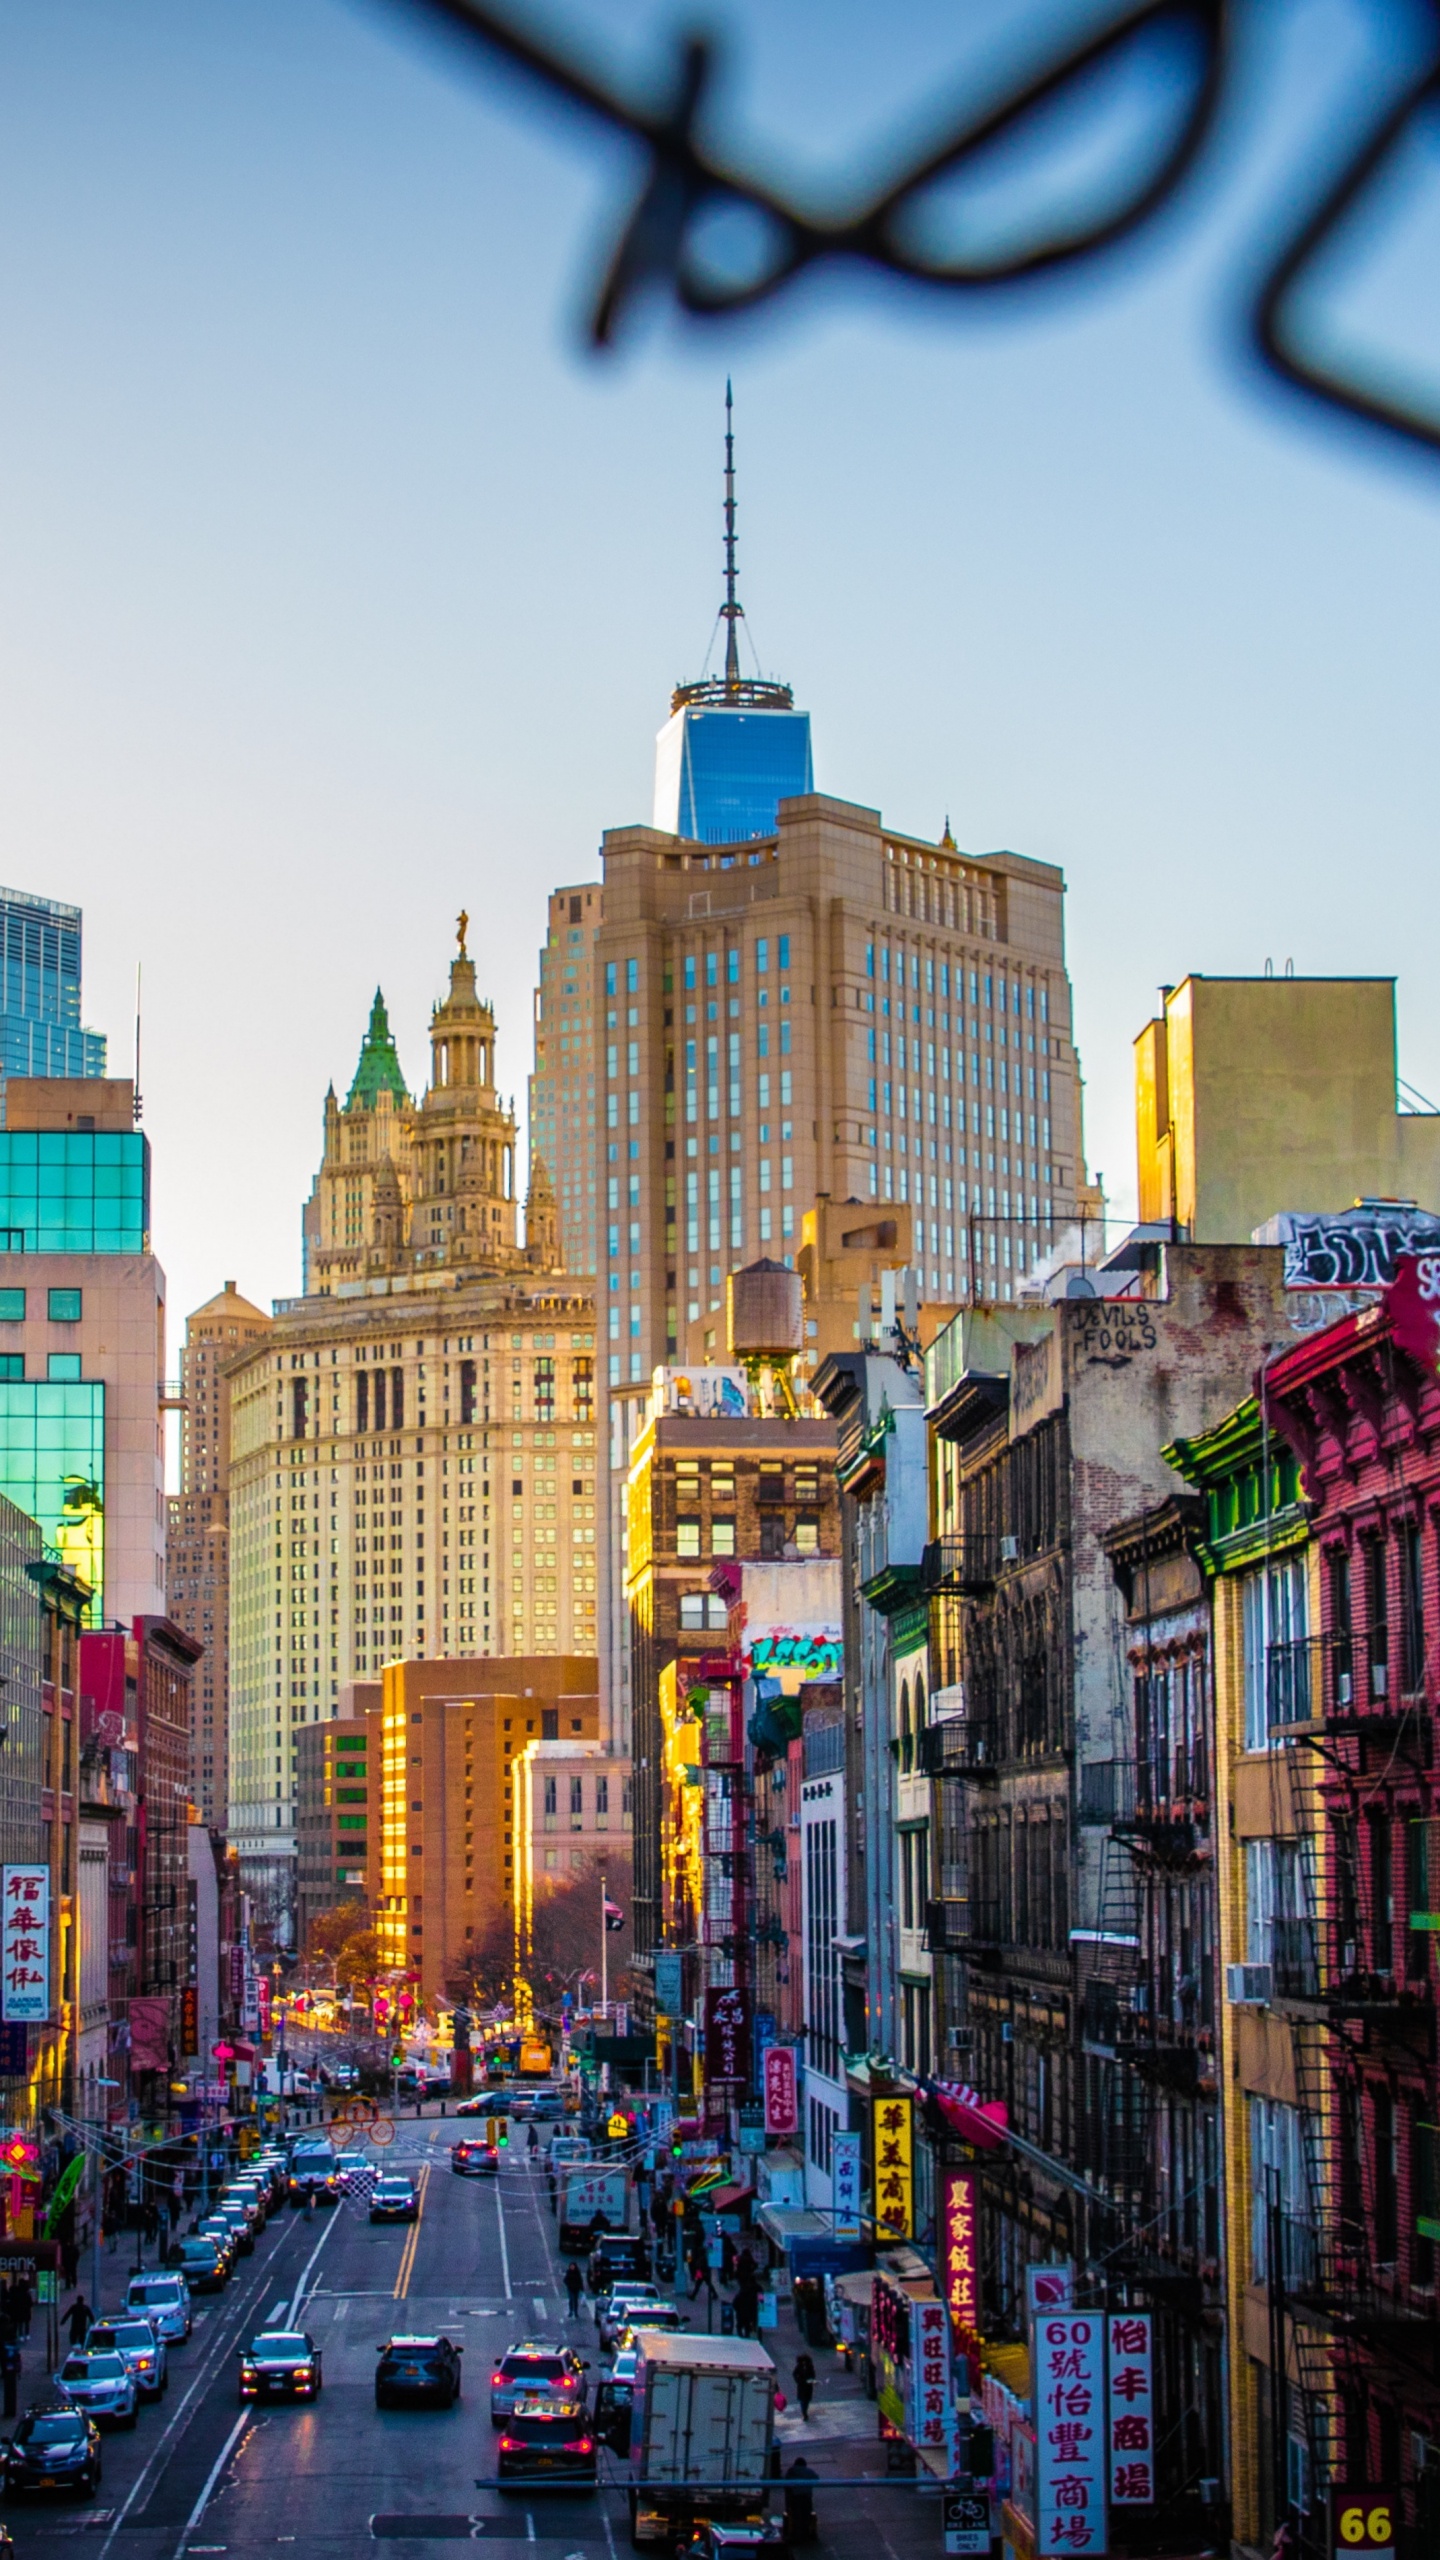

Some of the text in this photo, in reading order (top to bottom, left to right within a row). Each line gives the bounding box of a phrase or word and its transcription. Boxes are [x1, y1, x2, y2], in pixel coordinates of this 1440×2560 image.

[1083, 1325, 1157, 1350] FOOLS
[947, 2179, 976, 2306] 農家飯莊
[921, 2307, 946, 2443] 興旺旺商場
[1340, 2507, 1392, 2543] 66
